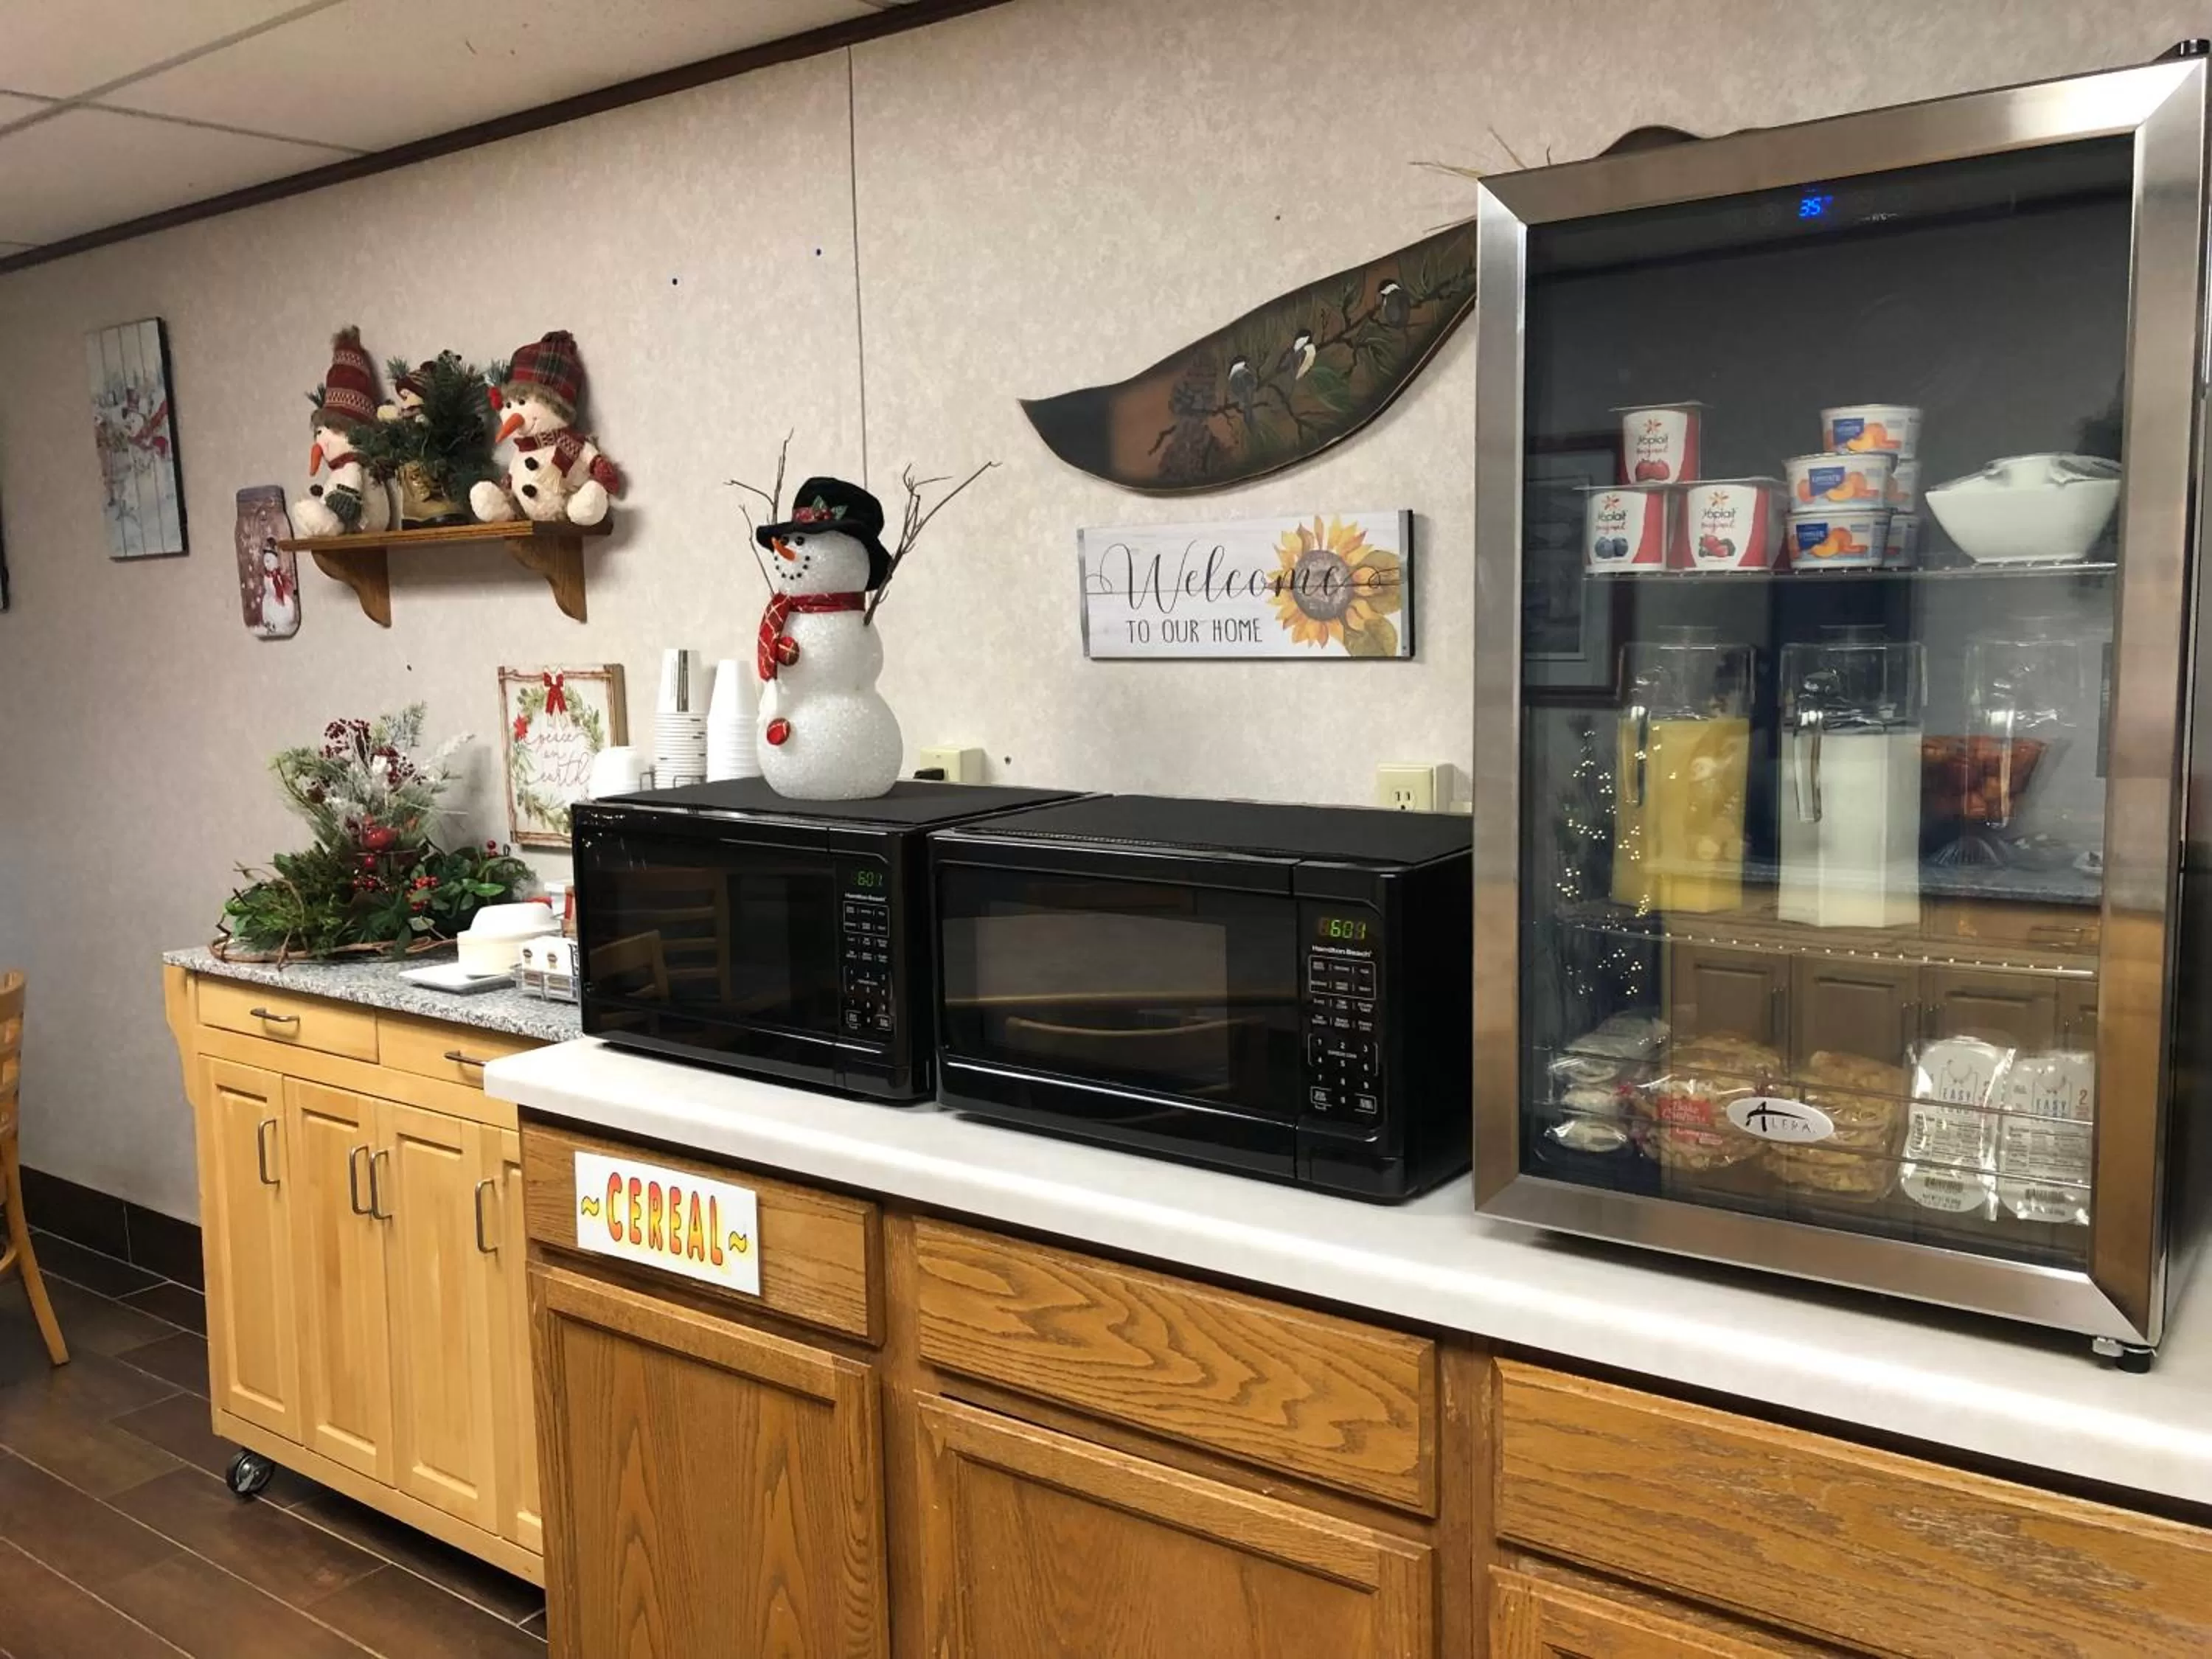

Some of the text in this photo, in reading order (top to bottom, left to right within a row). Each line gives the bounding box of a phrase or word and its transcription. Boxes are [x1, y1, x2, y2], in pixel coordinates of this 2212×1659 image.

[1087, 539, 1401, 613] Welcome
[1125, 617, 1263, 644] TO OUR HOME
